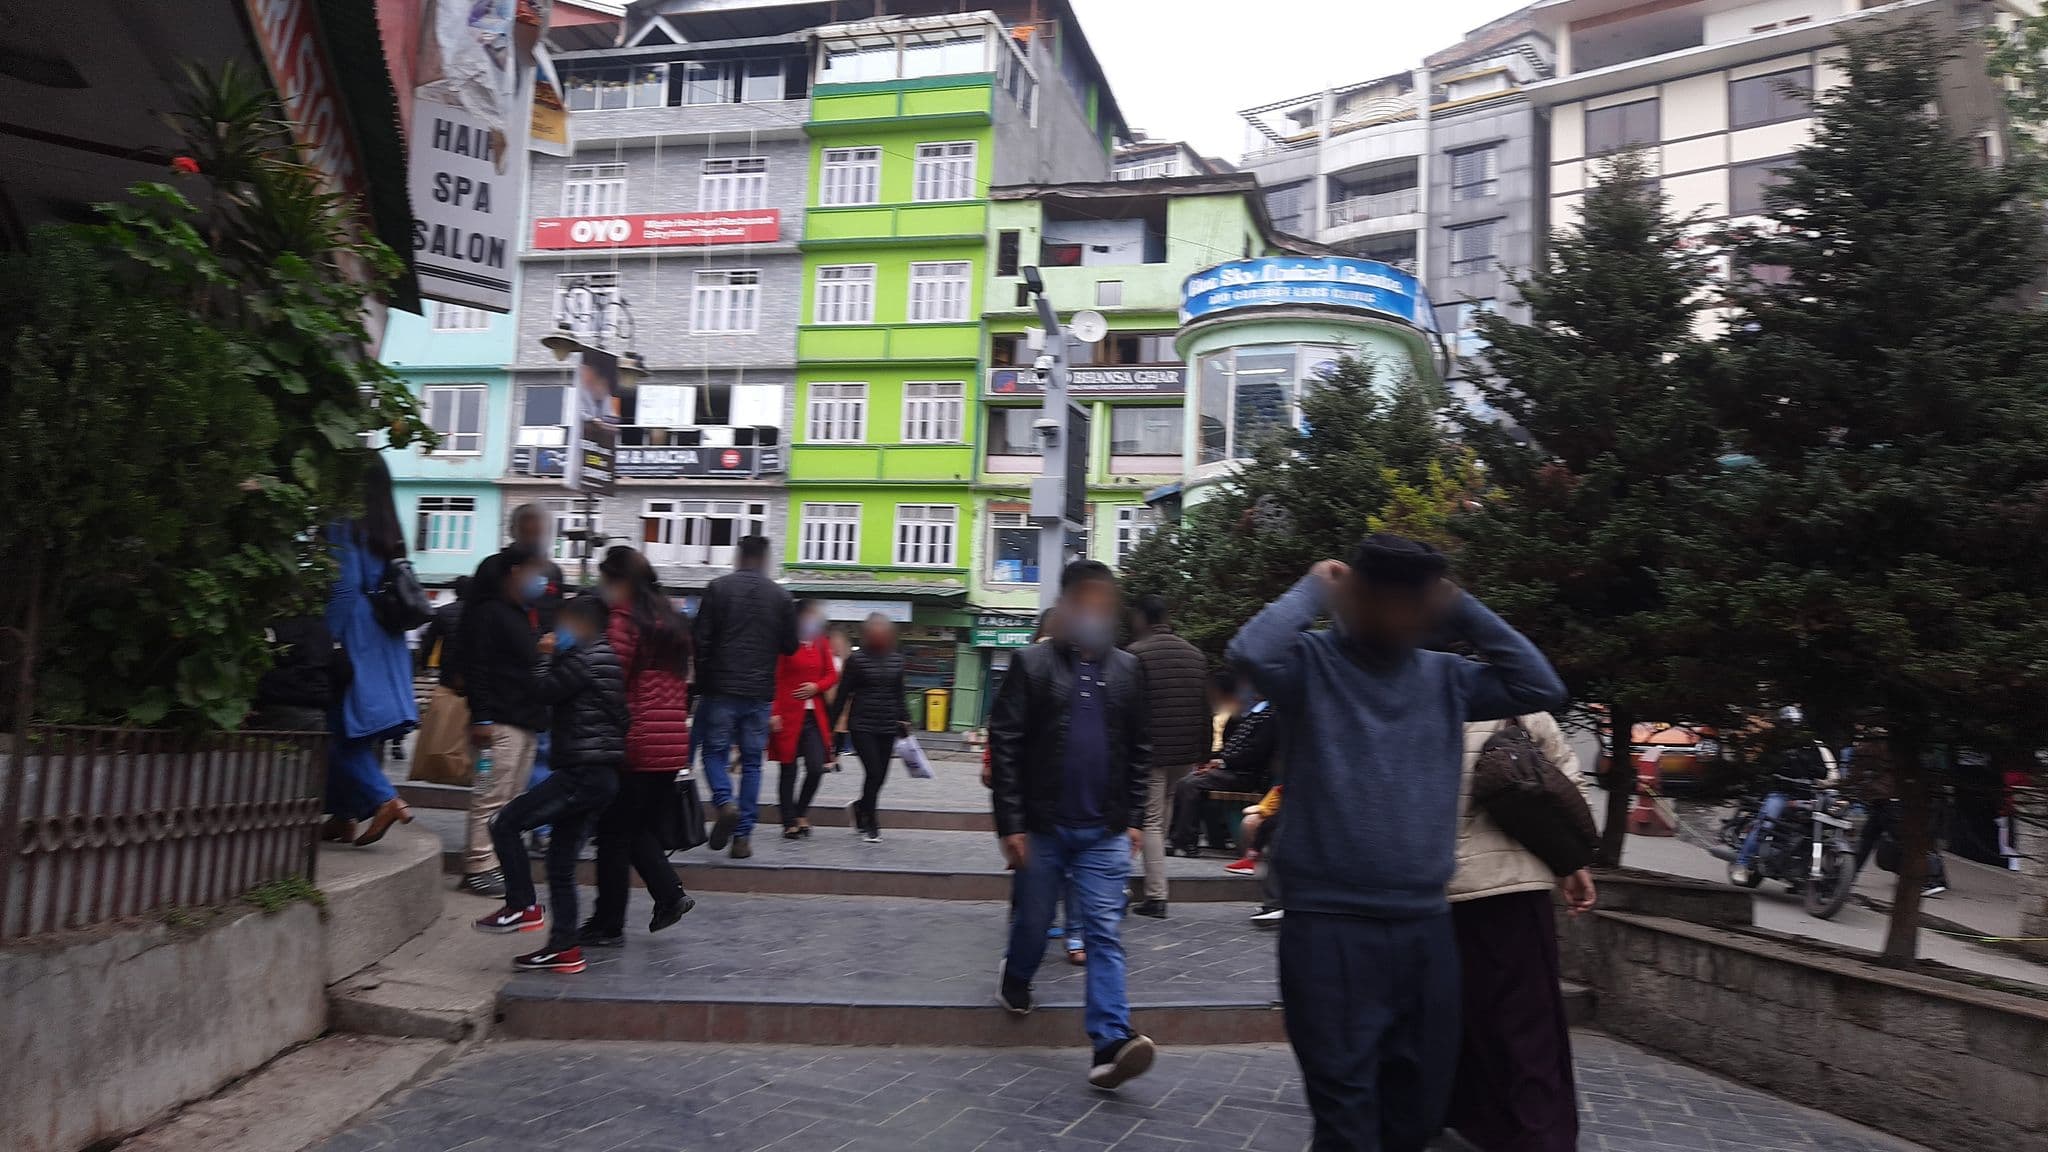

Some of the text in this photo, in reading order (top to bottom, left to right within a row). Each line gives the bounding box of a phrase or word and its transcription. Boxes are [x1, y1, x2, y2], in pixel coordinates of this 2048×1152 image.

[432, 171, 492, 213] SPA
[411, 219, 507, 269] SALON
[571, 218, 632, 243] OYO
